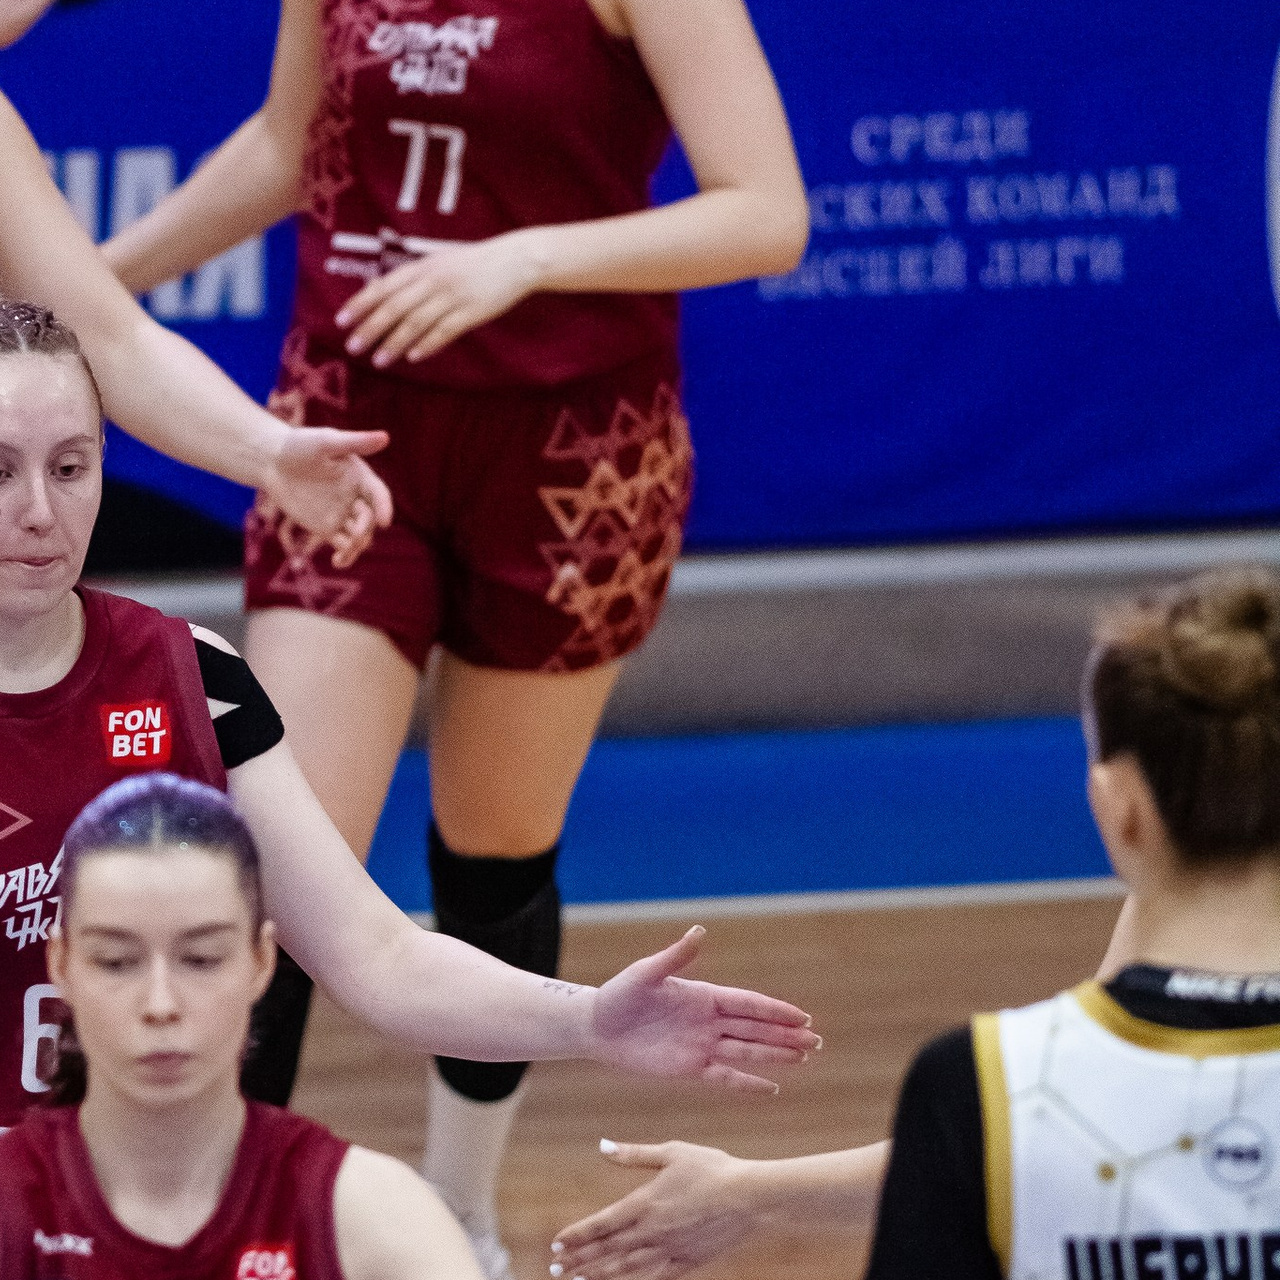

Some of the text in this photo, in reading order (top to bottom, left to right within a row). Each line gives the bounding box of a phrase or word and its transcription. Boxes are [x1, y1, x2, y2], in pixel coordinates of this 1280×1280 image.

[389, 120, 467, 212] 77
[108, 707, 161, 732] FON
[112, 729, 166, 757] BET
